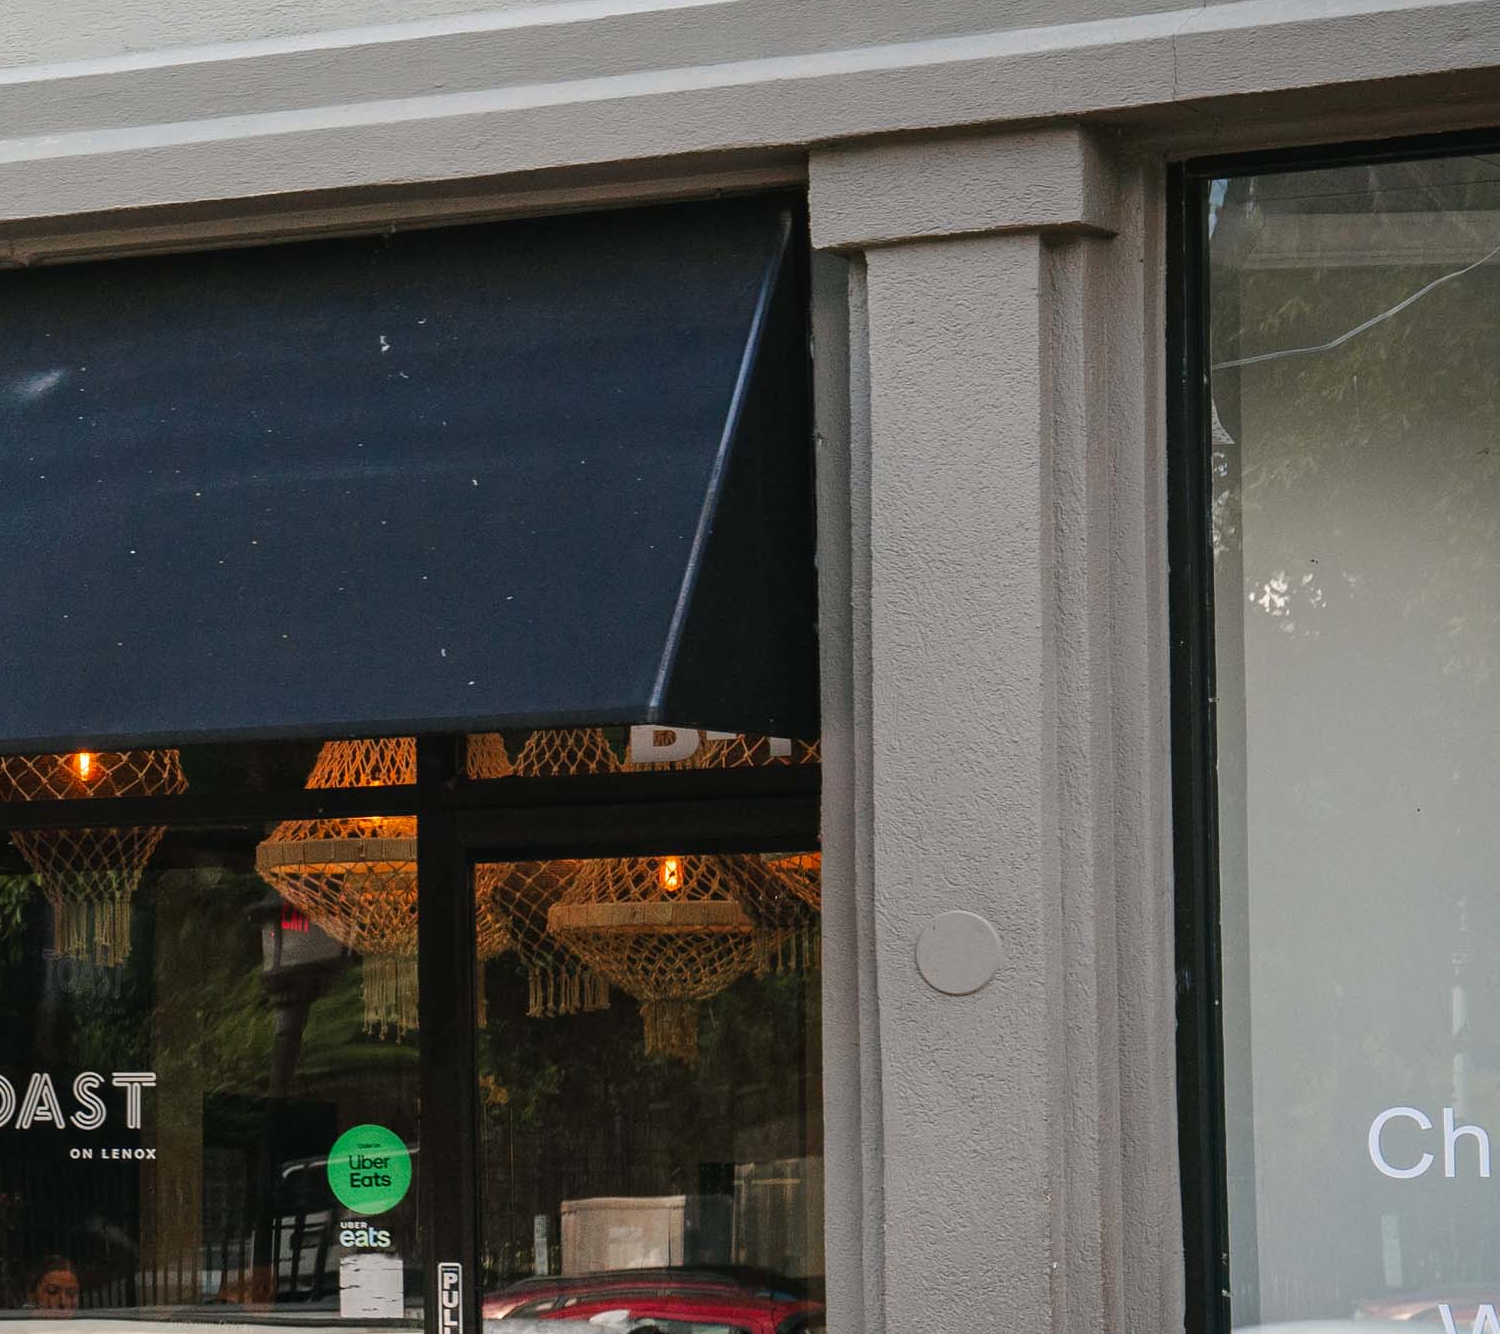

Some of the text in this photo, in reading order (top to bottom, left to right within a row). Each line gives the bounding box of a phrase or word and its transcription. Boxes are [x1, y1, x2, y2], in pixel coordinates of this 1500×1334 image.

[69, 1148, 157, 1160] ON LENOX
[349, 1155, 390, 1170] Uber
[350, 1172, 392, 1188] Eats
[340, 1227, 391, 1248] eats
